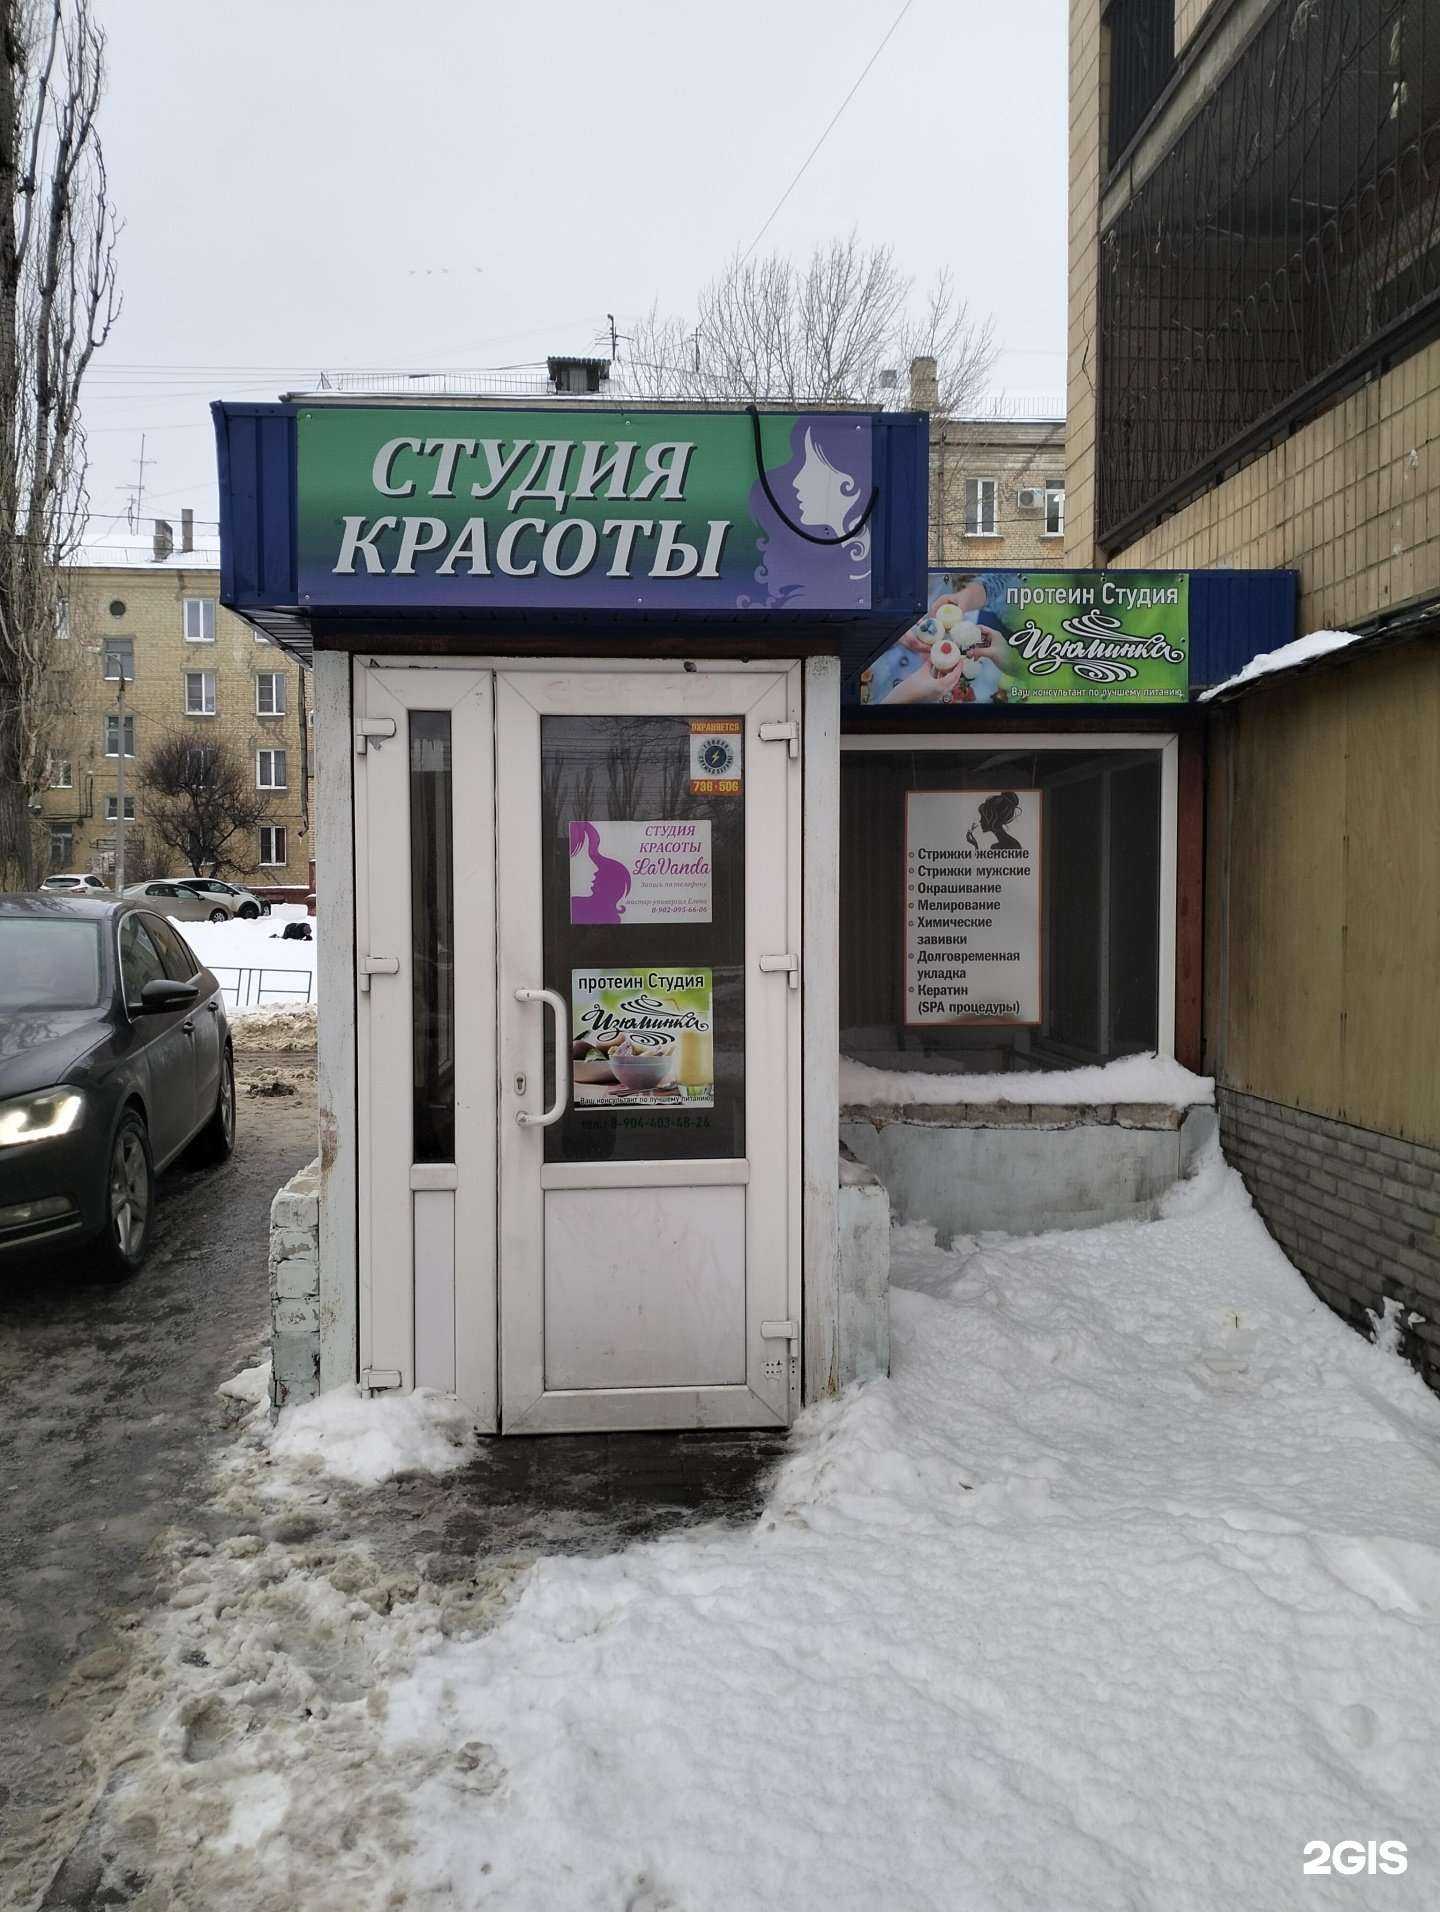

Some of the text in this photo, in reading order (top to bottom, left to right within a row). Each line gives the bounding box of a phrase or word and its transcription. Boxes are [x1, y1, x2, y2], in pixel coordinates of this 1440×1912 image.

[371, 436, 698, 512] СТУДИЯ
[332, 515, 731, 580] КРАСОТЫ
[1006, 583, 1178, 609] протеин Студия
[1008, 609, 1186, 682] Изюминка
[691, 721, 740, 732] ОХРАНЯЕТСЯ
[645, 825, 697, 839] СТУДИЯ
[639, 841, 702, 853] КРАСОТЫ
[917, 848, 1030, 861] Стрижки женские
[632, 855, 712, 876] LaVanda
[917, 865, 1031, 878] Стрижки мужские
[917, 882, 1002, 895] Окрашивание
[917, 899, 1001, 912] Мелирование
[917, 916, 993, 928] Химические
[917, 935, 968, 945] завивки
[917, 951, 1020, 964] Долговременная
[917, 969, 967, 980] укладка
[579, 973, 704, 993] протеин Студия
[917, 985, 969, 997] Кератин
[917, 1001, 1020, 1015] (SPA процедуры)
[581, 995, 709, 1046] Изюминка
